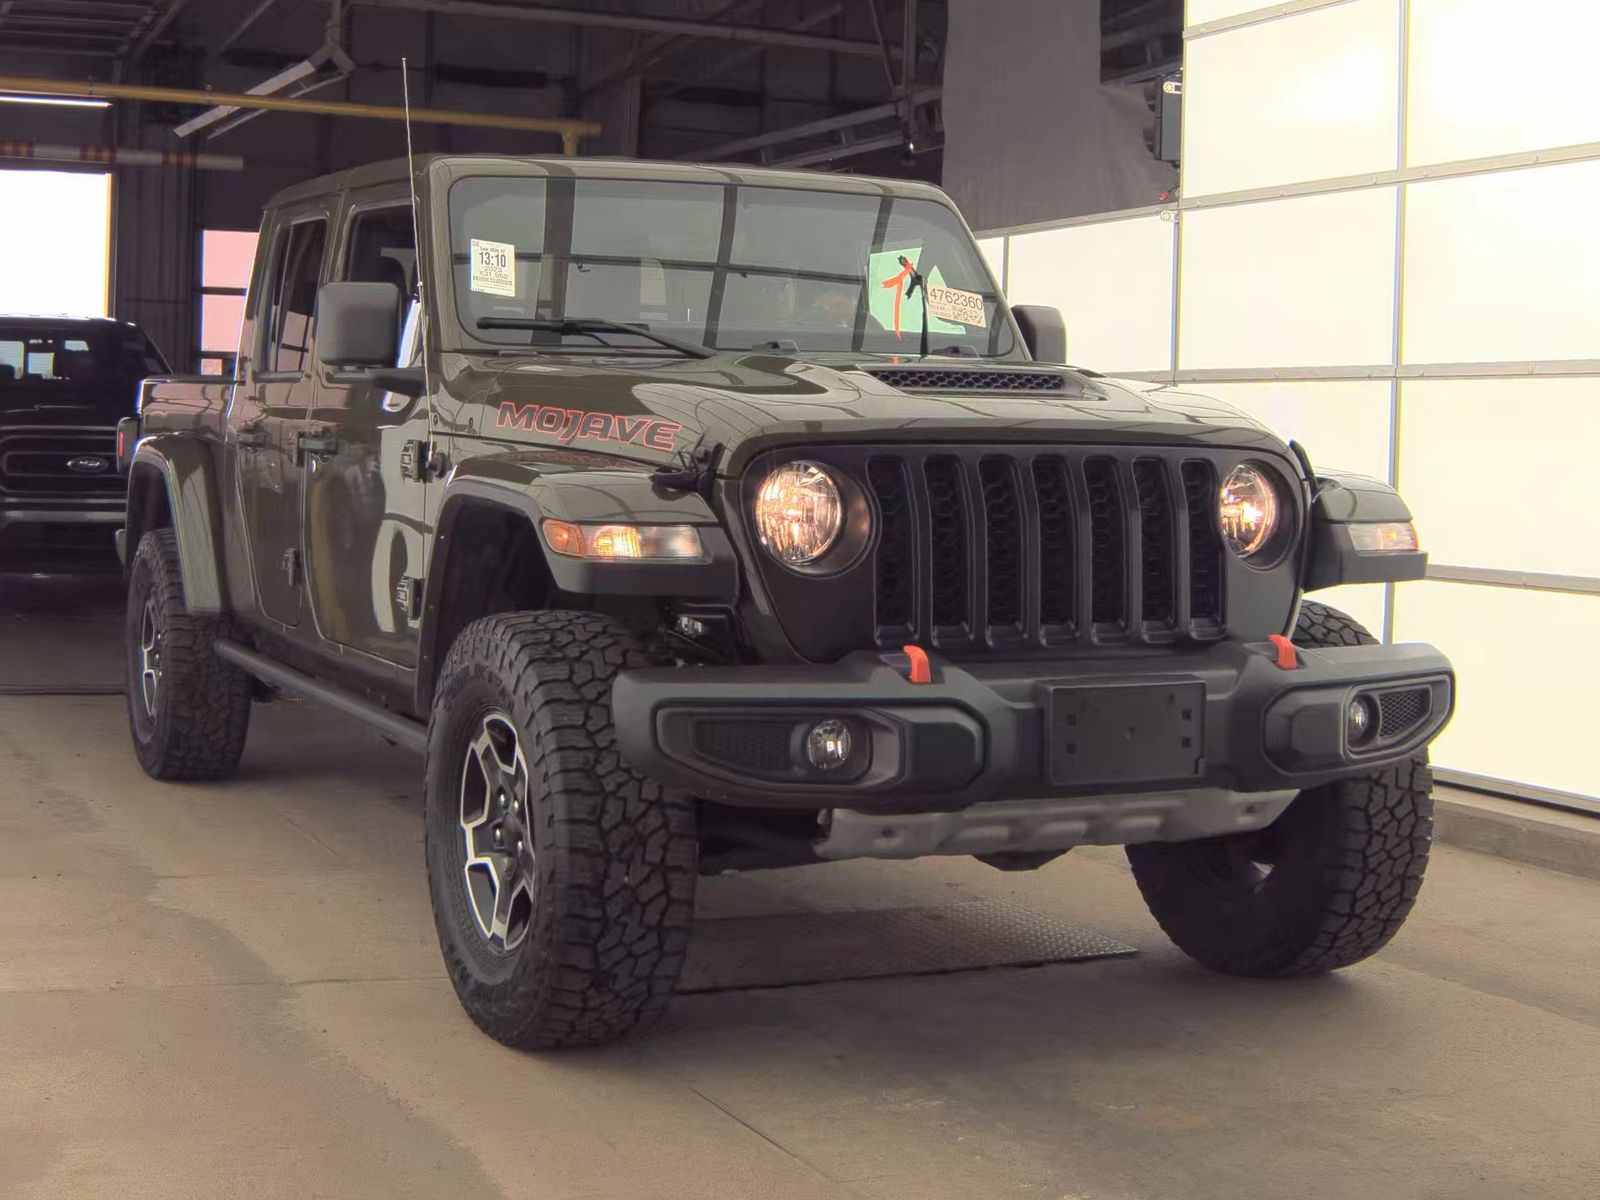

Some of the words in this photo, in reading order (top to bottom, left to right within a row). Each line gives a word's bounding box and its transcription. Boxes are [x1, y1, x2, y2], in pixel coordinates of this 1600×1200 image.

[479, 251, 506, 268] 13:10
[929, 287, 983, 311] 4762360
[496, 401, 682, 450] MOJAVE
